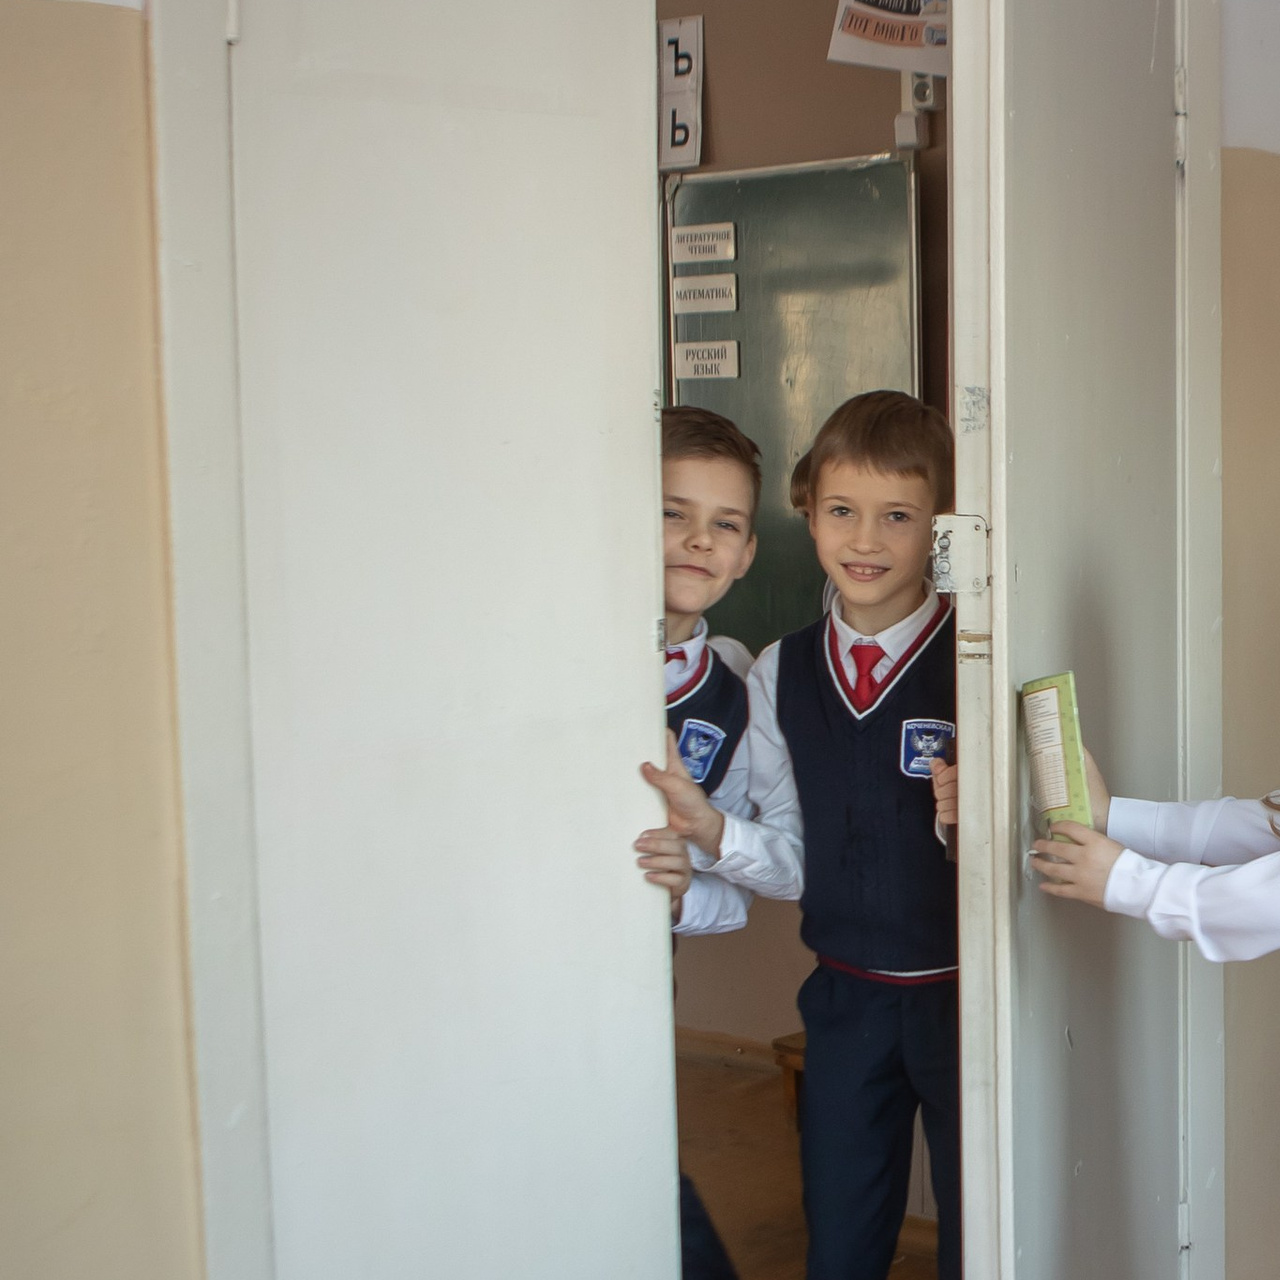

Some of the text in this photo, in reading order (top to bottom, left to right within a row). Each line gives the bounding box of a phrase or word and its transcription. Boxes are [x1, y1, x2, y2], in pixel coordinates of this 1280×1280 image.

[873, 21, 918, 41] МНОГО
[667, 38, 693, 77] Ъ
[670, 108, 690, 148] Ь
[675, 231, 732, 244] ЛИТЕРАТУРНОЕ
[688, 245, 717, 255] ЧТЕНИЕ
[675, 288, 733, 301] МАТЕМАТИКА
[685, 347, 727, 361] РУССКИЙ
[693, 363, 720, 376] ЯЗЫК
